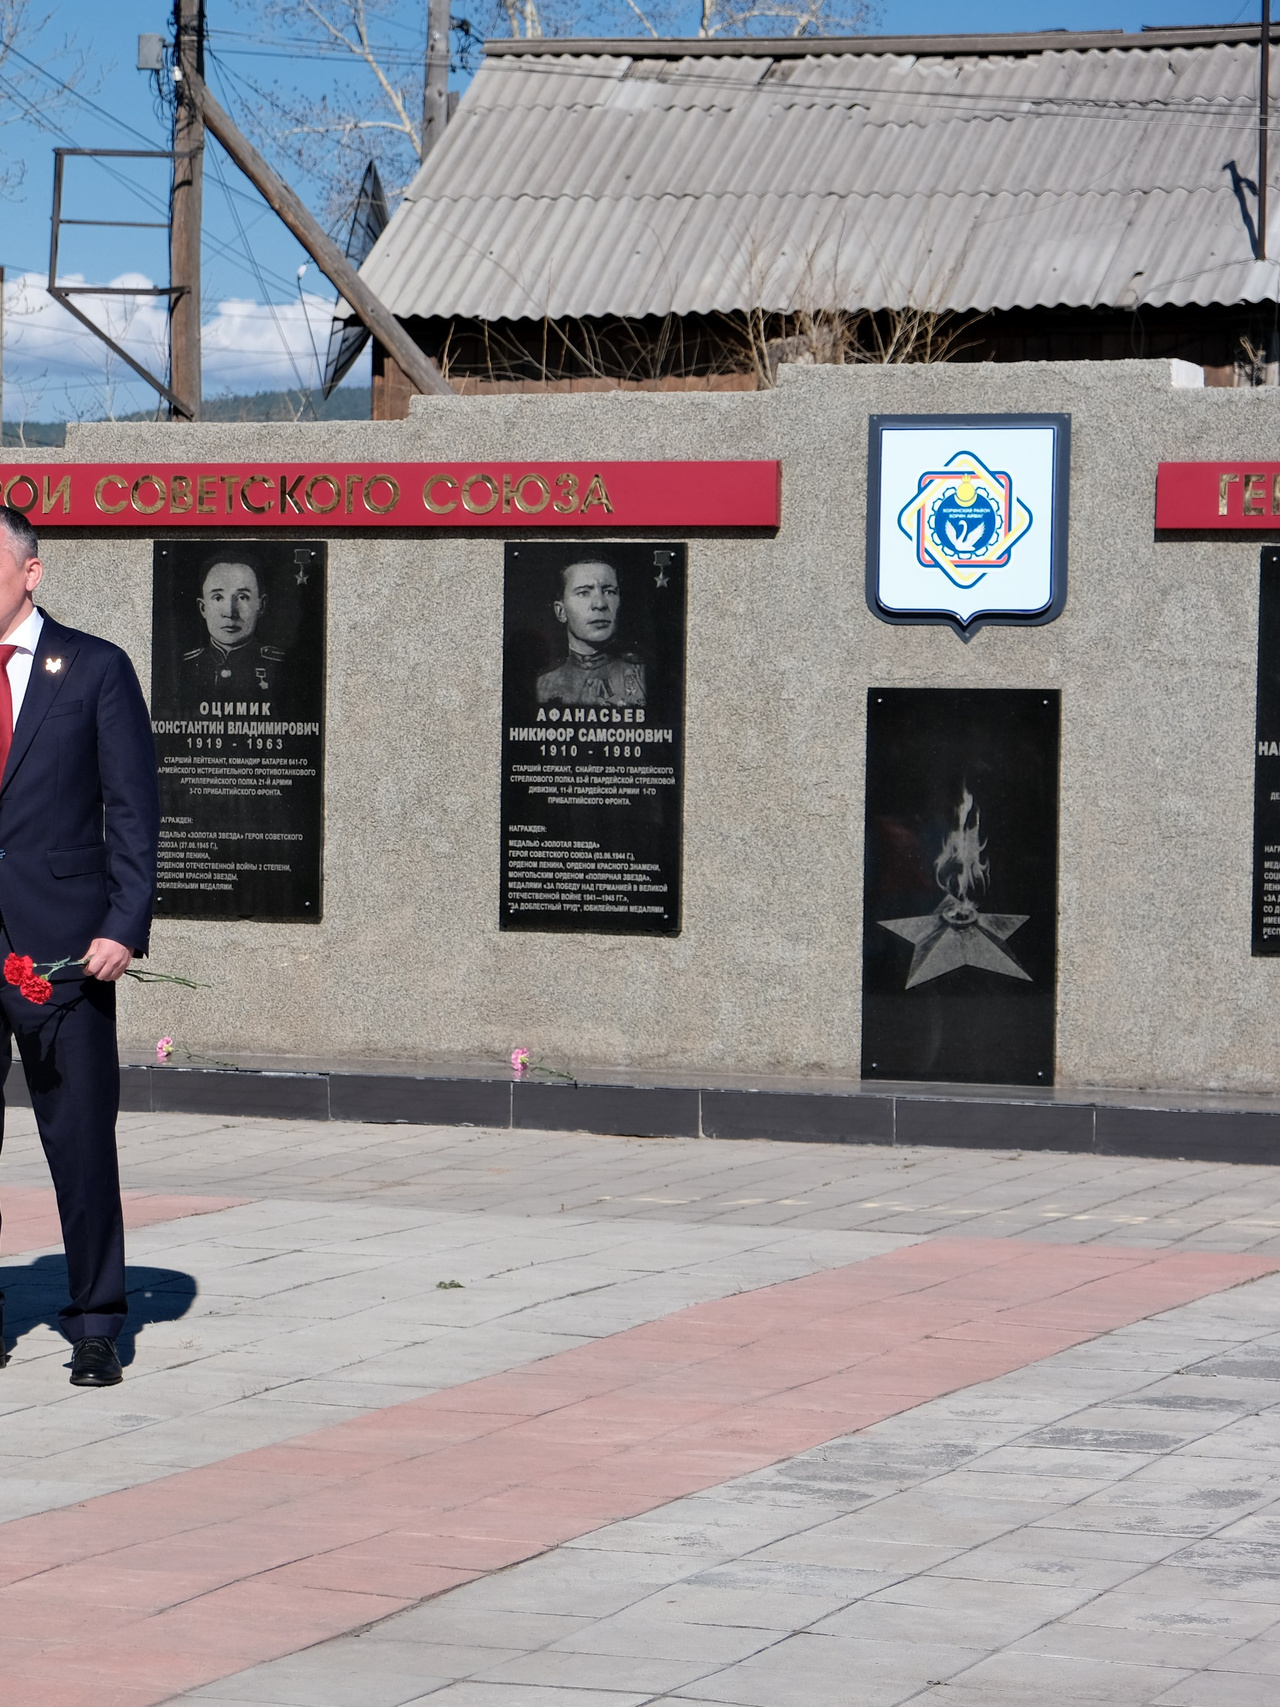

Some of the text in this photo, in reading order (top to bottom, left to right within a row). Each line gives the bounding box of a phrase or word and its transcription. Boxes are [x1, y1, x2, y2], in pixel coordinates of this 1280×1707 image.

[93, 474, 400, 514] СОВЕТСКОГО
[422, 473, 614, 514] СОЮЗА
[200, 702, 271, 717] ОЦИМИК
[536, 708, 646, 722] АФАНАСЬЕВ
[152, 721, 319, 737] КОНСТАНТИН ВЛАДИМИРОВИЧ
[510, 728, 672, 742] НИКИФОР САМСОНОВИЧ
[187, 738, 222, 748] 1919
[247, 739, 283, 749] 1963
[540, 745, 577, 756] 1910
[604, 746, 641, 757] 1980
[164, 756, 191, 764] СТАРШИЙ
[193, 756, 227, 765] ЛЕЙТЕНАНТ,
[229, 758, 260, 766] КОМАНДИР
[158, 766, 196, 774] АРМЕЙСКОГО
[512, 764, 541, 772] СТАРШИЙ
[543, 765, 572, 774] СЕРЖАНТ,
[575, 765, 604, 773] СНАЙПЕР
[627, 765, 673, 775] ГВАРДЕЙСКОГО
[181, 777, 236, 785] АРТИЛЛЕРИЙСКОГО
[555, 776, 575, 784] ПОЛКА
[590, 776, 633, 785] ГВАРДЕЙСКОЙ
[635, 777, 675, 785] СТРЕЛКОВОЙ
[204, 787, 256, 795] ПРИБАЛТИЙСКОГО
[574, 786, 617, 795] ГВАРДЕЙСКОЙ
[548, 796, 603, 805] ПРИБАЛТИЙСКОГО
[509, 825, 547, 833] НАГРАЖДЕН:
[509, 840, 539, 848] МЕДАЛЬЮ
[186, 852, 210, 860] ЛЕНИНА,
[186, 861, 235, 870] ОТЕЧЕСТВЕННОЙ
[236, 862, 257, 870] ВОЙНЫ
[264, 864, 291, 872] СТЕПЕНИ,
[509, 861, 537, 869] ОРДЕНОМ
[566, 862, 596, 870] ОРДЕНОМ
[597, 863, 628, 871] КРАСНОГО
[186, 871, 212, 880] КРАСНОЙ
[555, 872, 584, 880] ОРДЕНОМ
[157, 881, 198, 889] ЮБИЛЕЙНЫМИ
[556, 883, 580, 891] ПОБЕДУ
[596, 883, 632, 891] ГЕРМАНИЕЙ
[639, 884, 668, 892] ВЕЛИКОЙ
[508, 891, 559, 900] ОТЕЧЕСТВЕННОЙ
[560, 892, 582, 900] ВОЙНЕ
[520, 902, 562, 911] ДОБЛЕСТНЫЙ
[584, 903, 628, 912] ЮБИЛЕЙНЫМИ
[630, 905, 664, 914] МЕДАЛЯМИ
